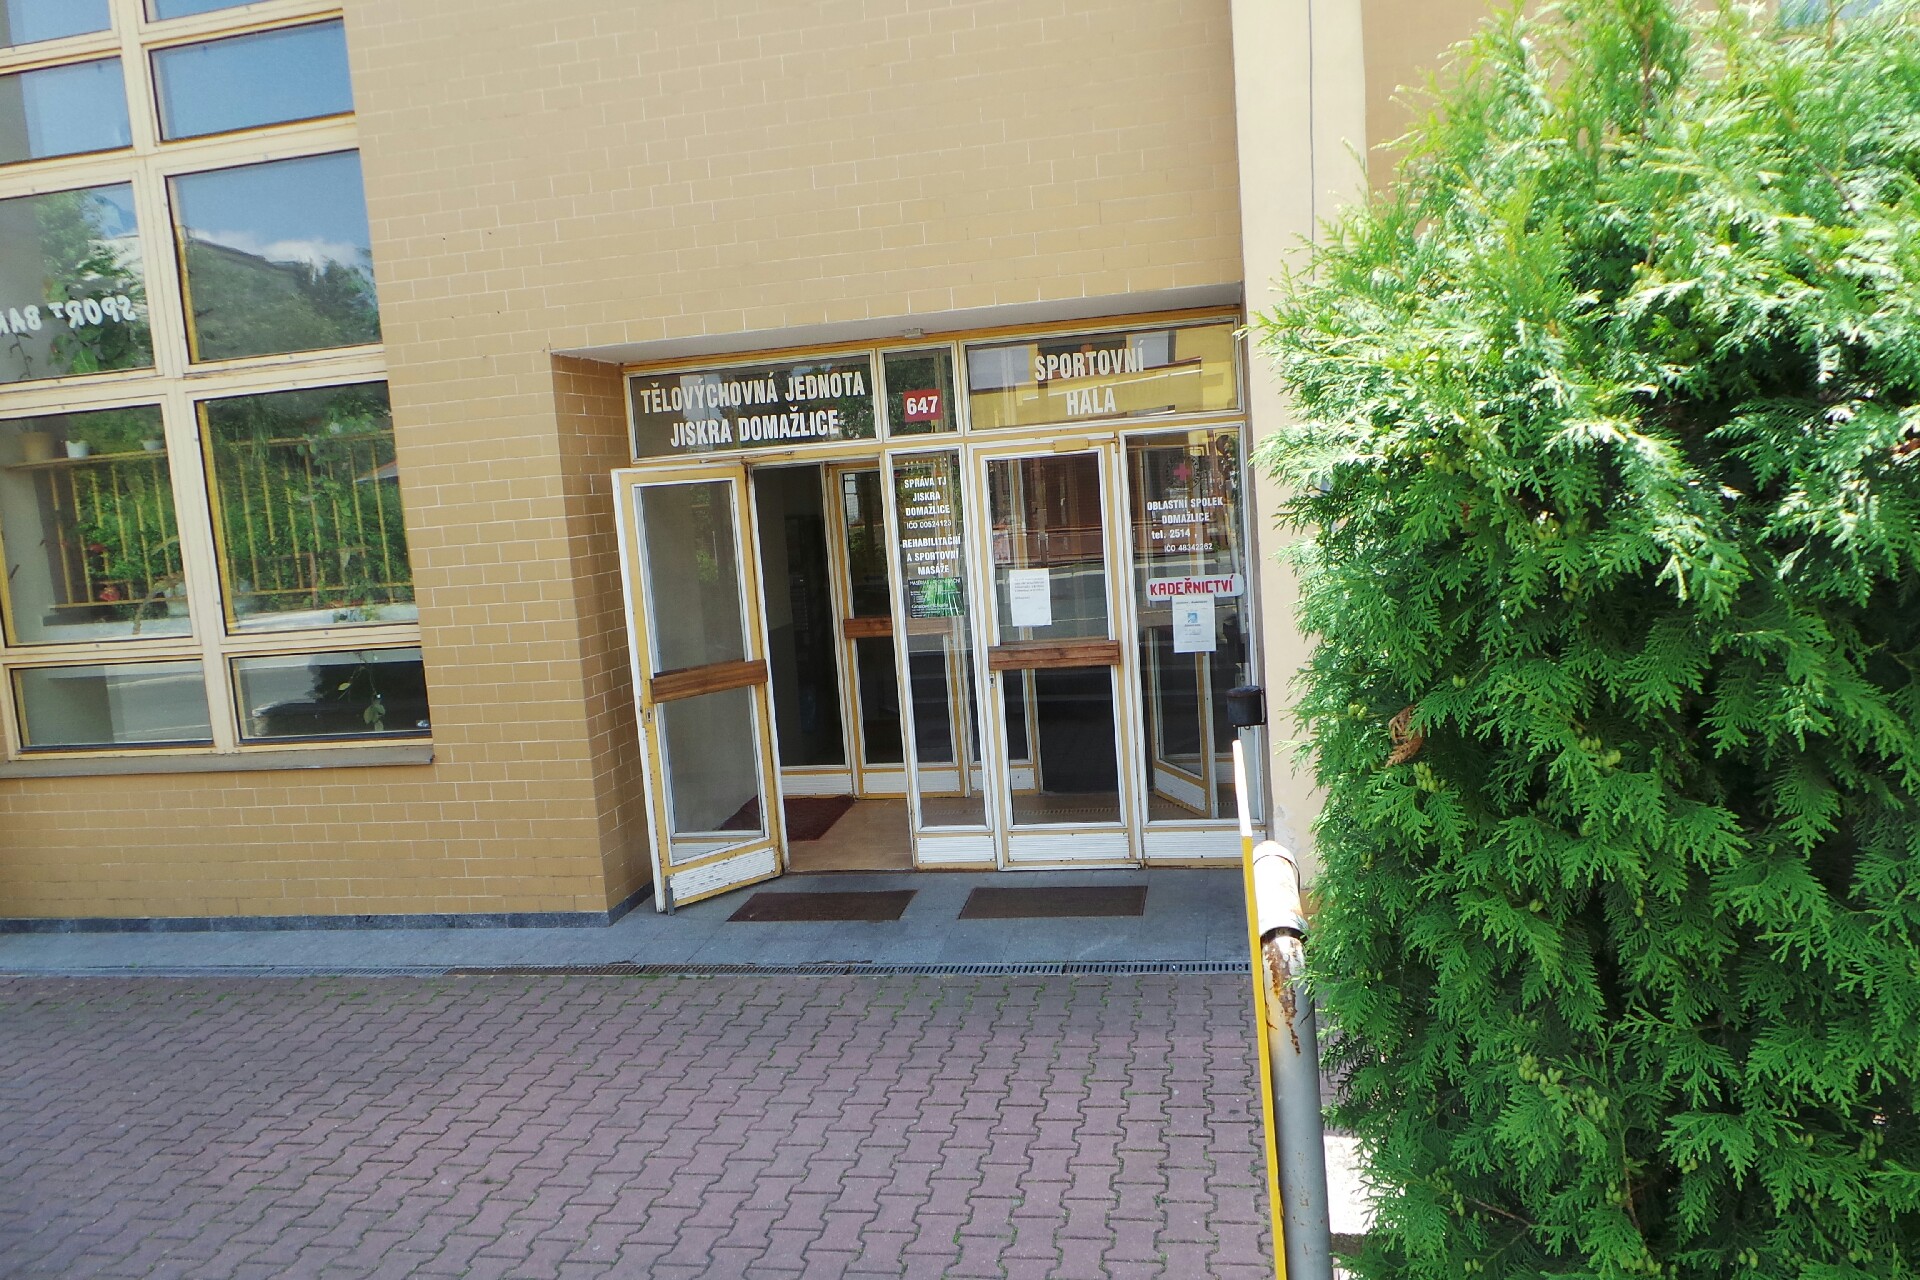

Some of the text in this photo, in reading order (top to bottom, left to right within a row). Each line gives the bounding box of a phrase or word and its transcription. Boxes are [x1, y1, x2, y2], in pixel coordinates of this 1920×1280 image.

[1034, 340, 1144, 382] SPORTOVNÍ
[640, 371, 866, 414] TĚLOVÝCHOVNÁ JEDNOTA
[906, 395, 939, 416] 647
[1066, 387, 1118, 416] HALA
[670, 406, 841, 447] JISKRA DOMAŽLICE
[904, 475, 947, 489] SPRÁVA TJ
[912, 491, 941, 502] JISKRA
[905, 503, 951, 517] DOMAŽLICE
[1147, 497, 1224, 511] OBLASTNÍ SPOLEK
[1162, 511, 1210, 525] DOMAŽLICE
[902, 533, 961, 548] REHABILITAČNÍ
[1151, 528, 1191, 540] tel. 2514
[907, 548, 959, 562] A SPORTOVNÍ
[917, 563, 950, 576] MASÁŽE
[1149, 574, 1234, 596] KADEŘNICTVÍ
